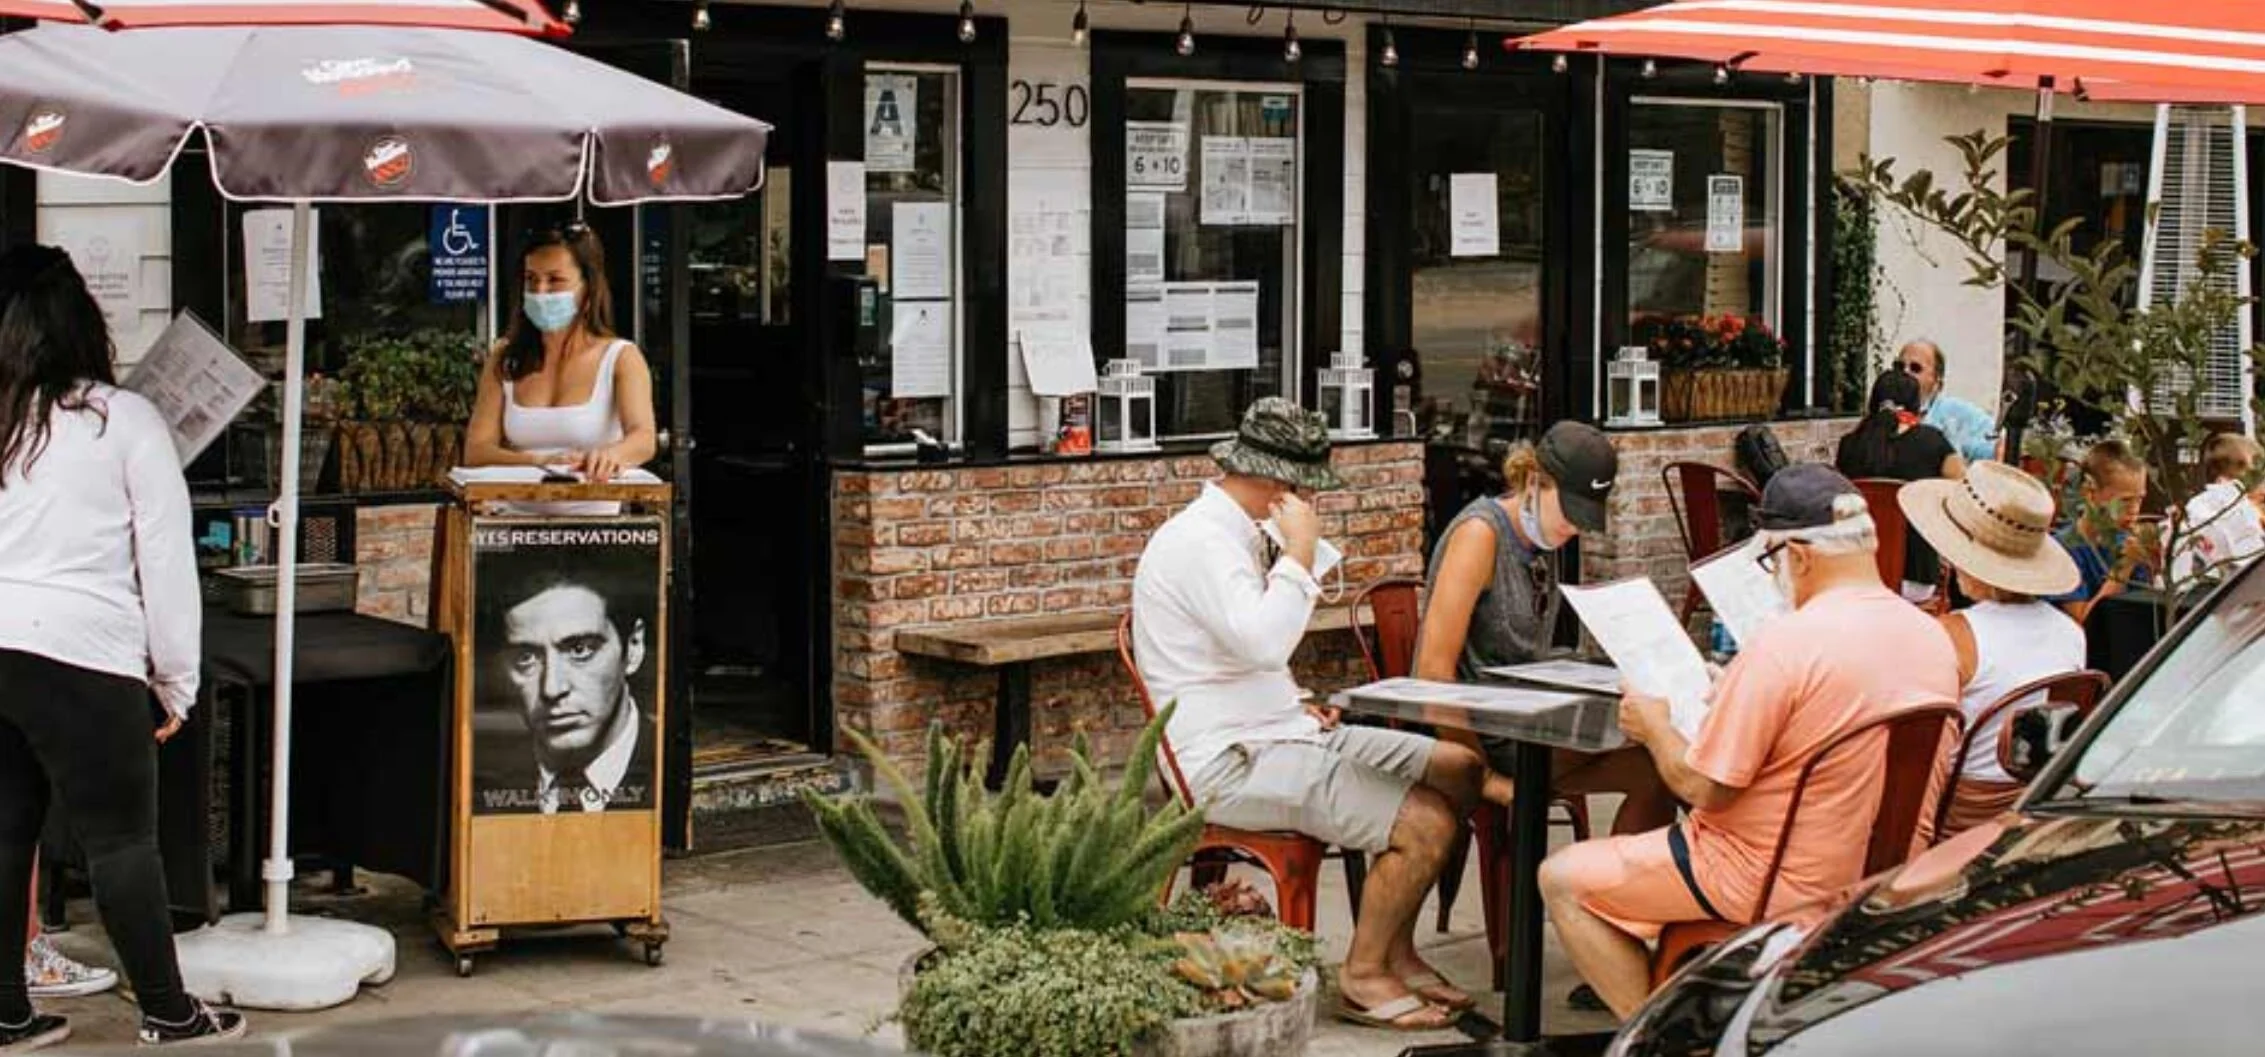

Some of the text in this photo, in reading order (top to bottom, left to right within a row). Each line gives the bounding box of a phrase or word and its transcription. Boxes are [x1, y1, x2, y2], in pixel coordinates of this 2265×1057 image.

[870, 88, 903, 136] A
[1009, 79, 1089, 128] 250
[477, 528, 659, 547] YES RESERVATIONS
[585, 784, 646, 803] ONLY
